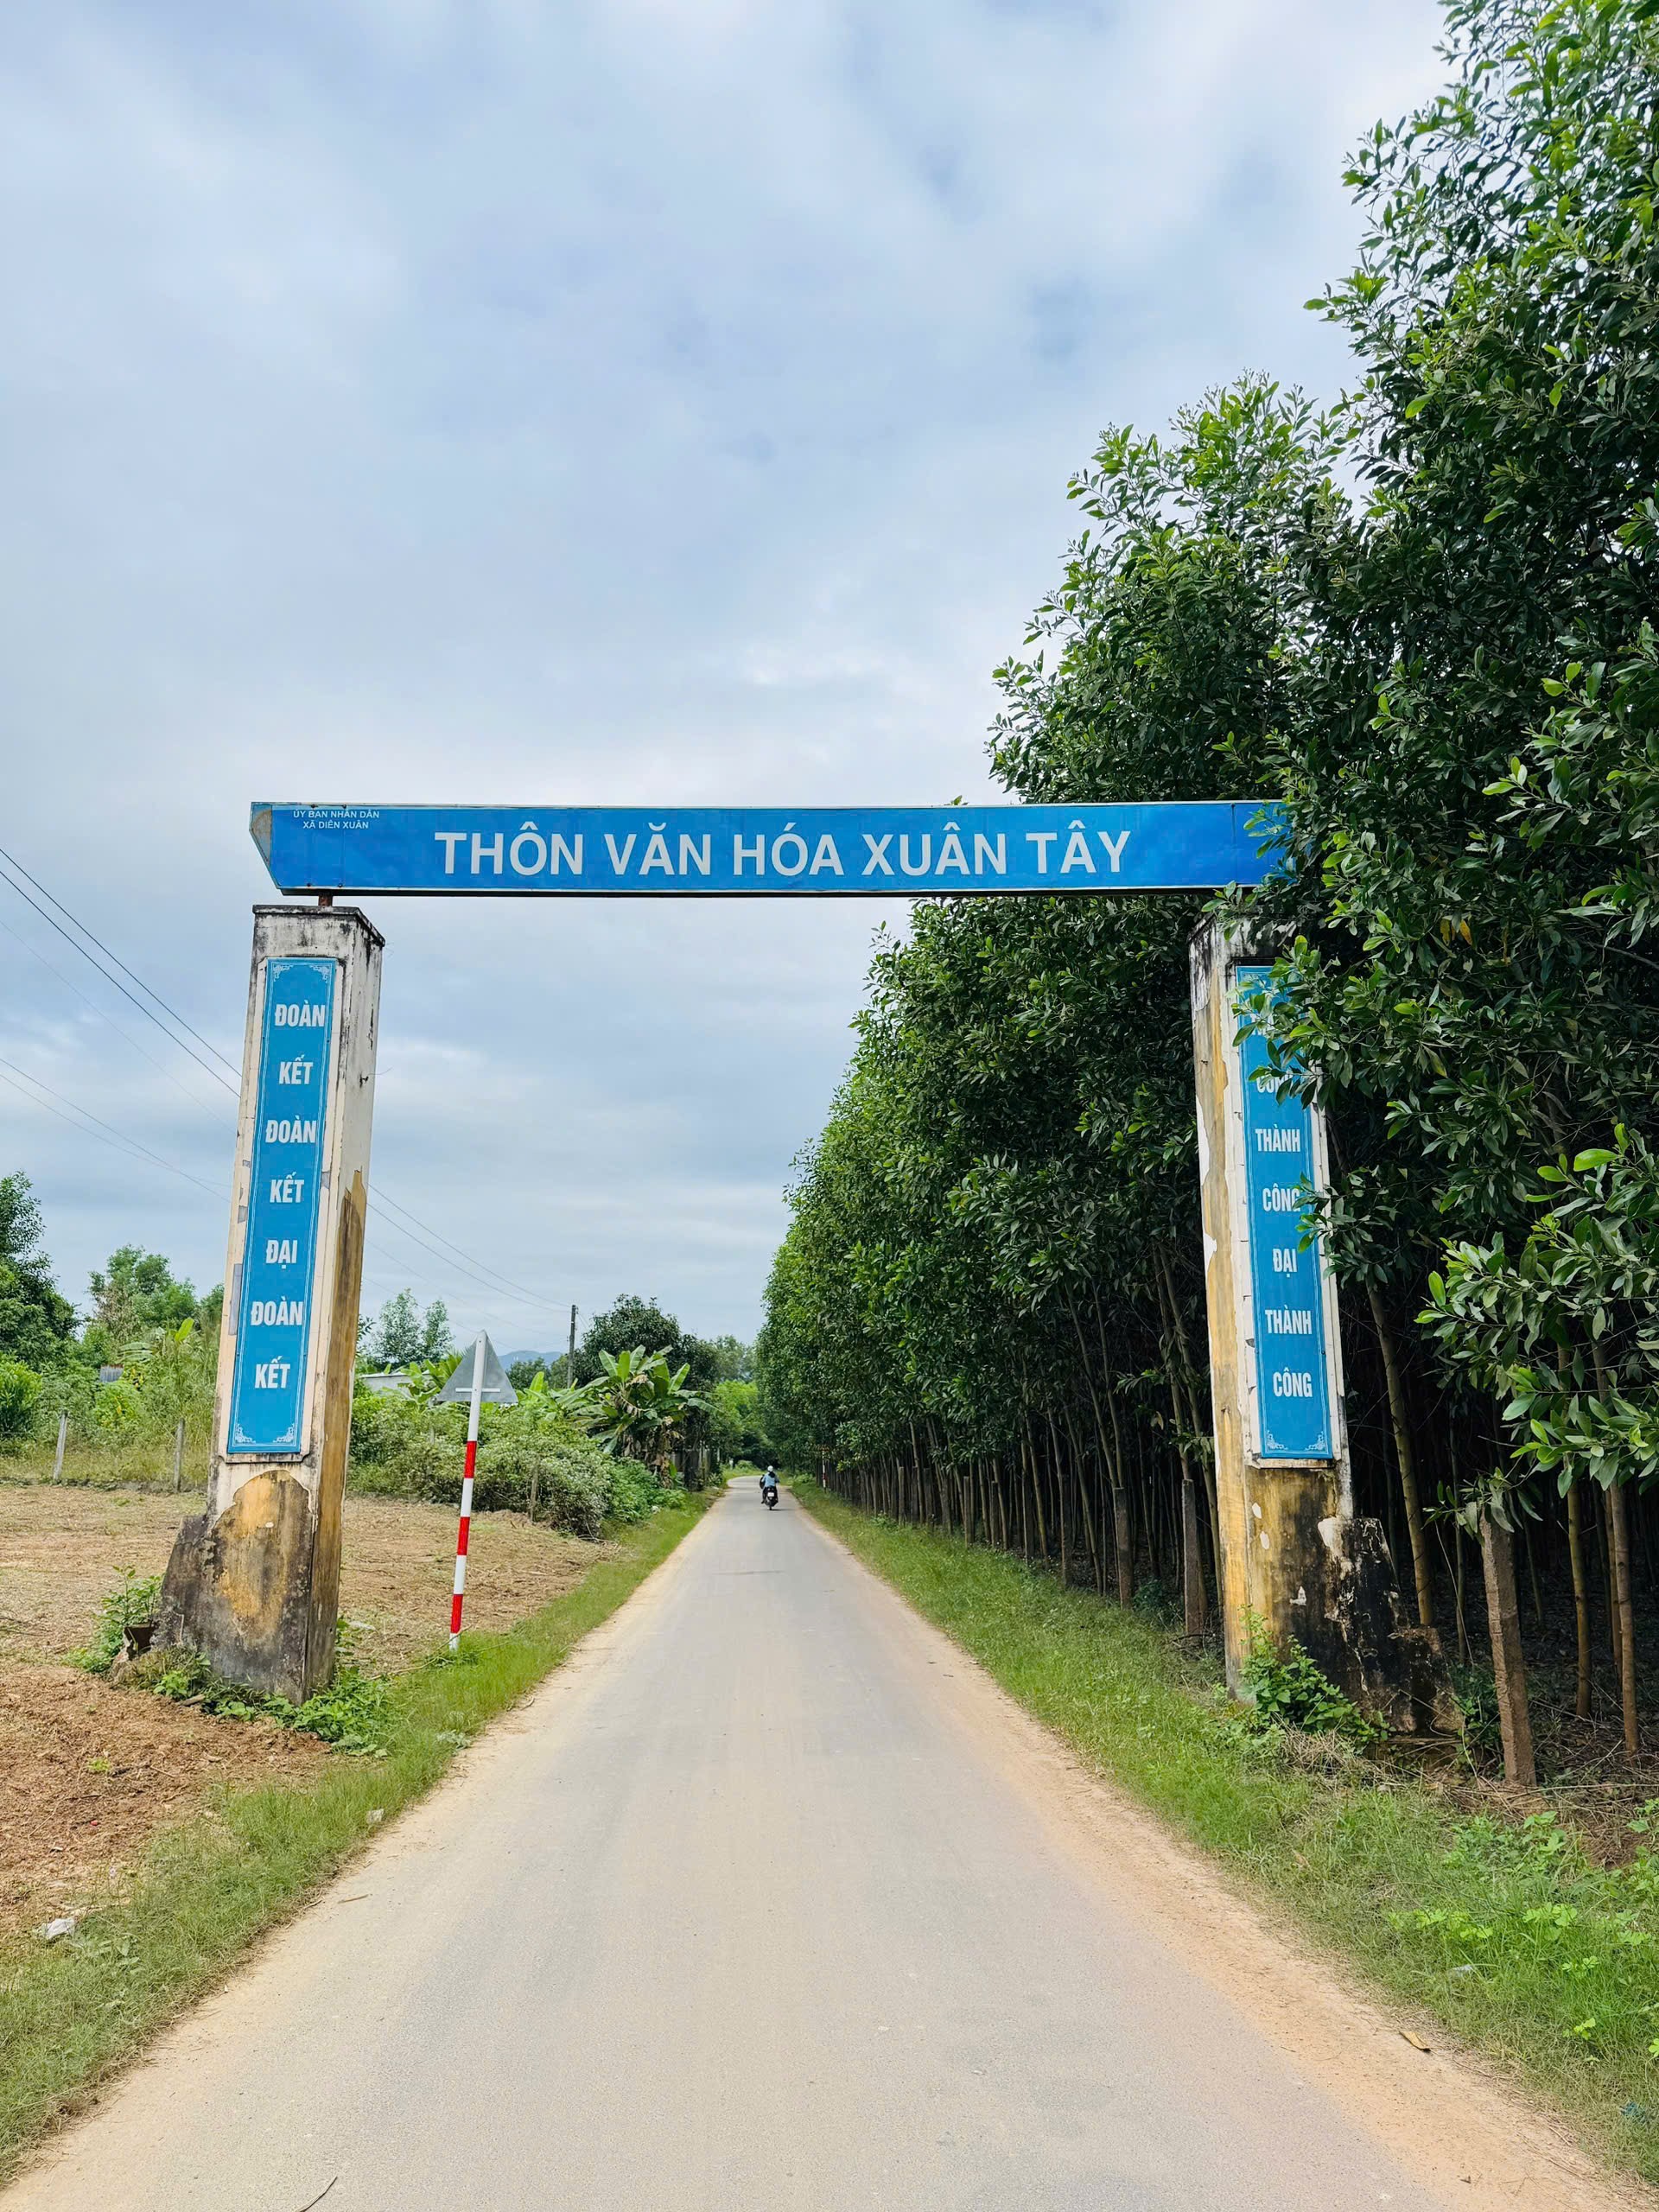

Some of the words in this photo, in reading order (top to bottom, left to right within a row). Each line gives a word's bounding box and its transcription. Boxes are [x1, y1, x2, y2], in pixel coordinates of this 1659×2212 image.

[343, 819, 369, 829] XUÂN
[435, 821, 583, 875] THÔN
[604, 822, 711, 875] VĂN
[734, 822, 844, 875] HÓA
[861, 822, 1007, 875] XUÂN
[1026, 819, 1131, 874] TÂY
[275, 1000, 326, 1027] ĐOÀN
[278, 1054, 314, 1084] KẾT
[265, 1116, 317, 1144] ĐOÀN
[1255, 1123, 1300, 1153] THÀNH
[270, 1172, 304, 1203] KẾT
[266, 1239, 298, 1269] ĐẠI
[1272, 1248, 1298, 1278] ĐẠI
[251, 1296, 303, 1326] ĐOÀN
[1264, 1304, 1313, 1335] THÀNH
[254, 1355, 291, 1389] KẾT
[1273, 1367, 1313, 1398] CÔNG
